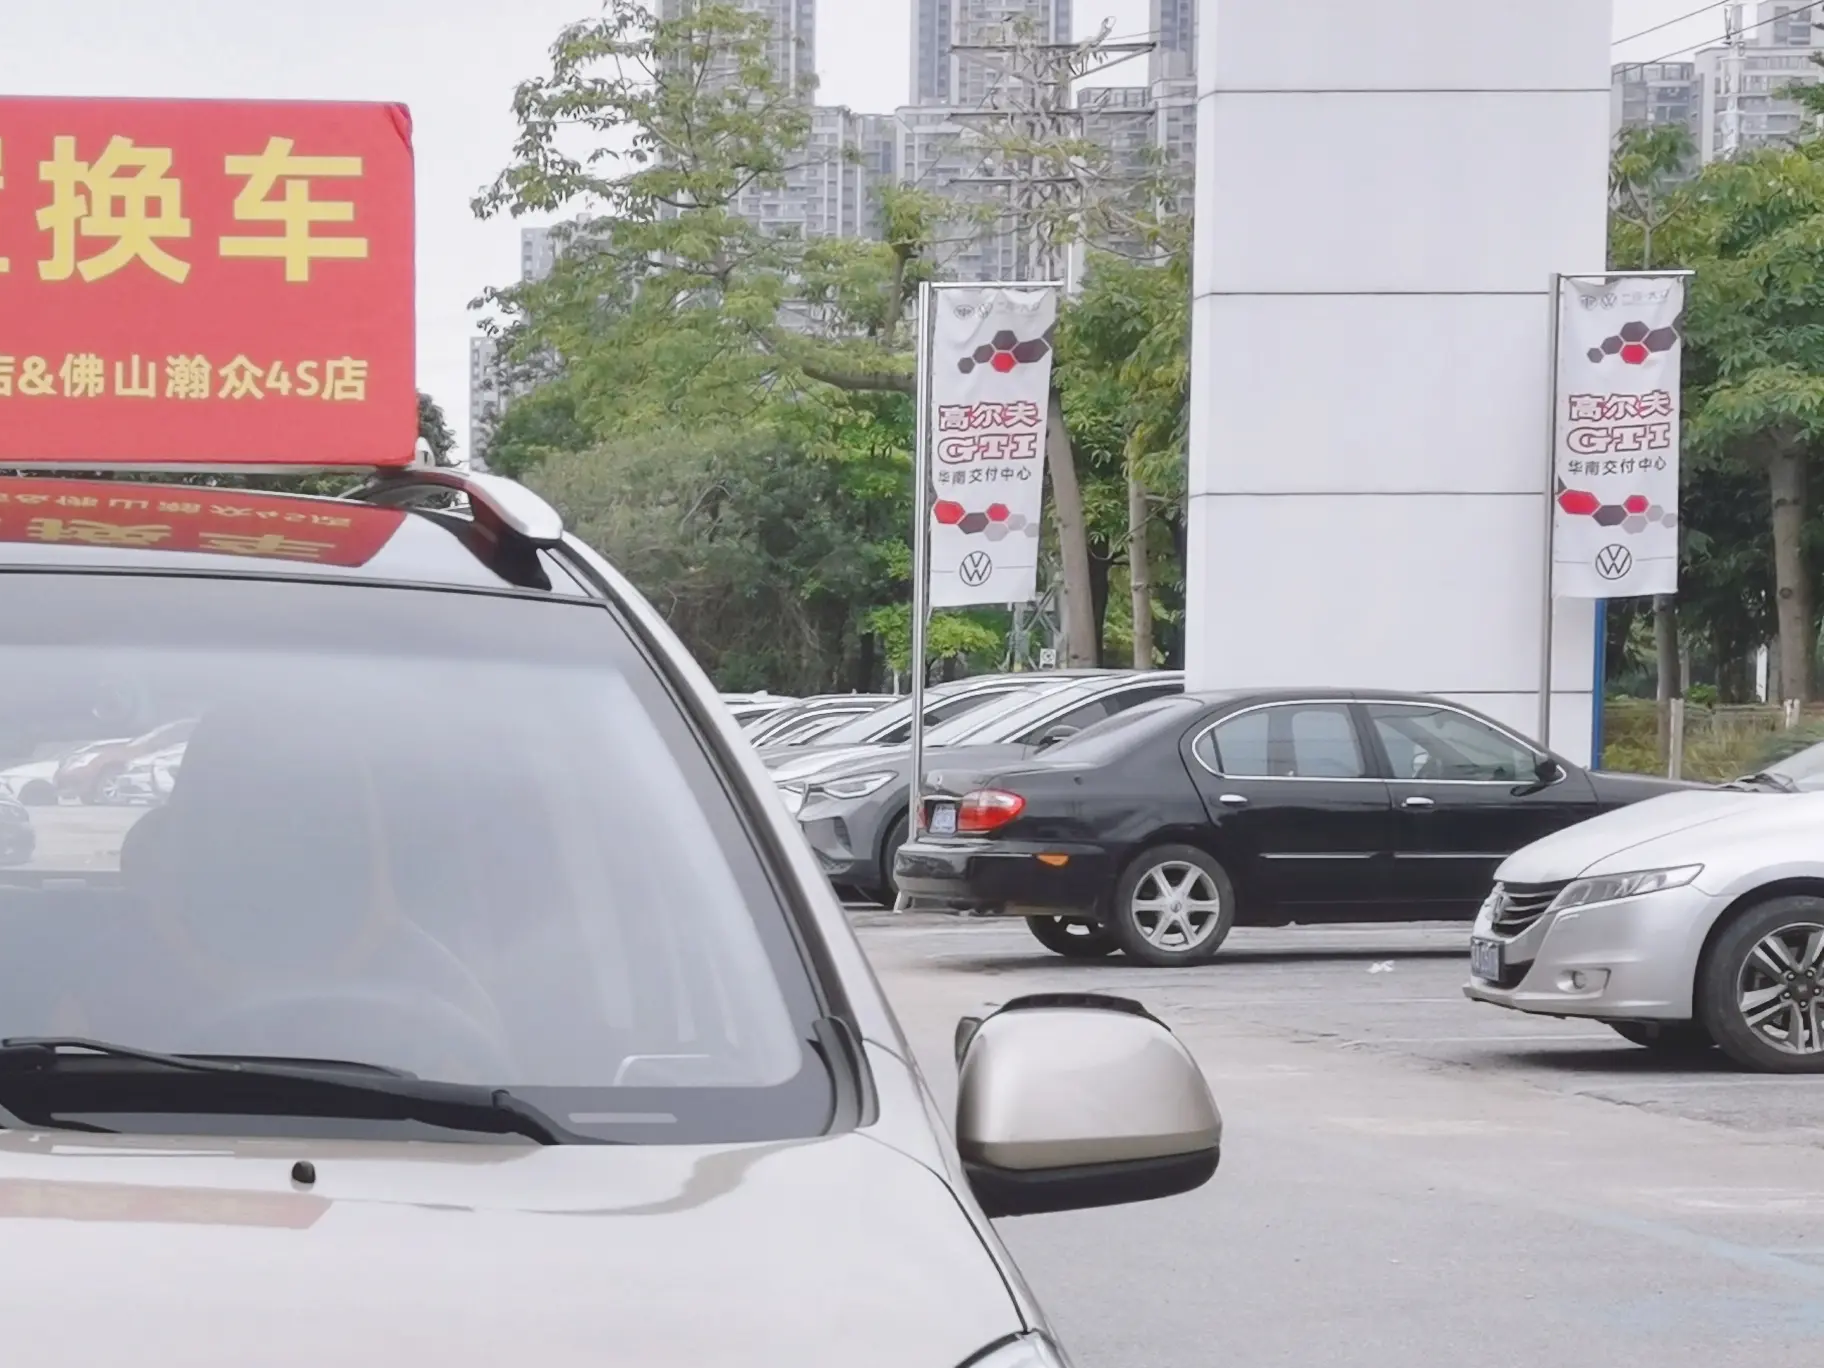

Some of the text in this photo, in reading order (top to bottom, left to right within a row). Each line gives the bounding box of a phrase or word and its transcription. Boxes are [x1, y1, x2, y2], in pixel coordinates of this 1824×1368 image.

[939, 401, 1042, 431] 高尔夫
[1569, 390, 1674, 422] 高尔夫
[938, 433, 1037, 464] GTI
[1567, 422, 1670, 454] GTI
[939, 465, 1031, 486] 华南交付中心
[1568, 455, 1667, 477] 华南交付中心
